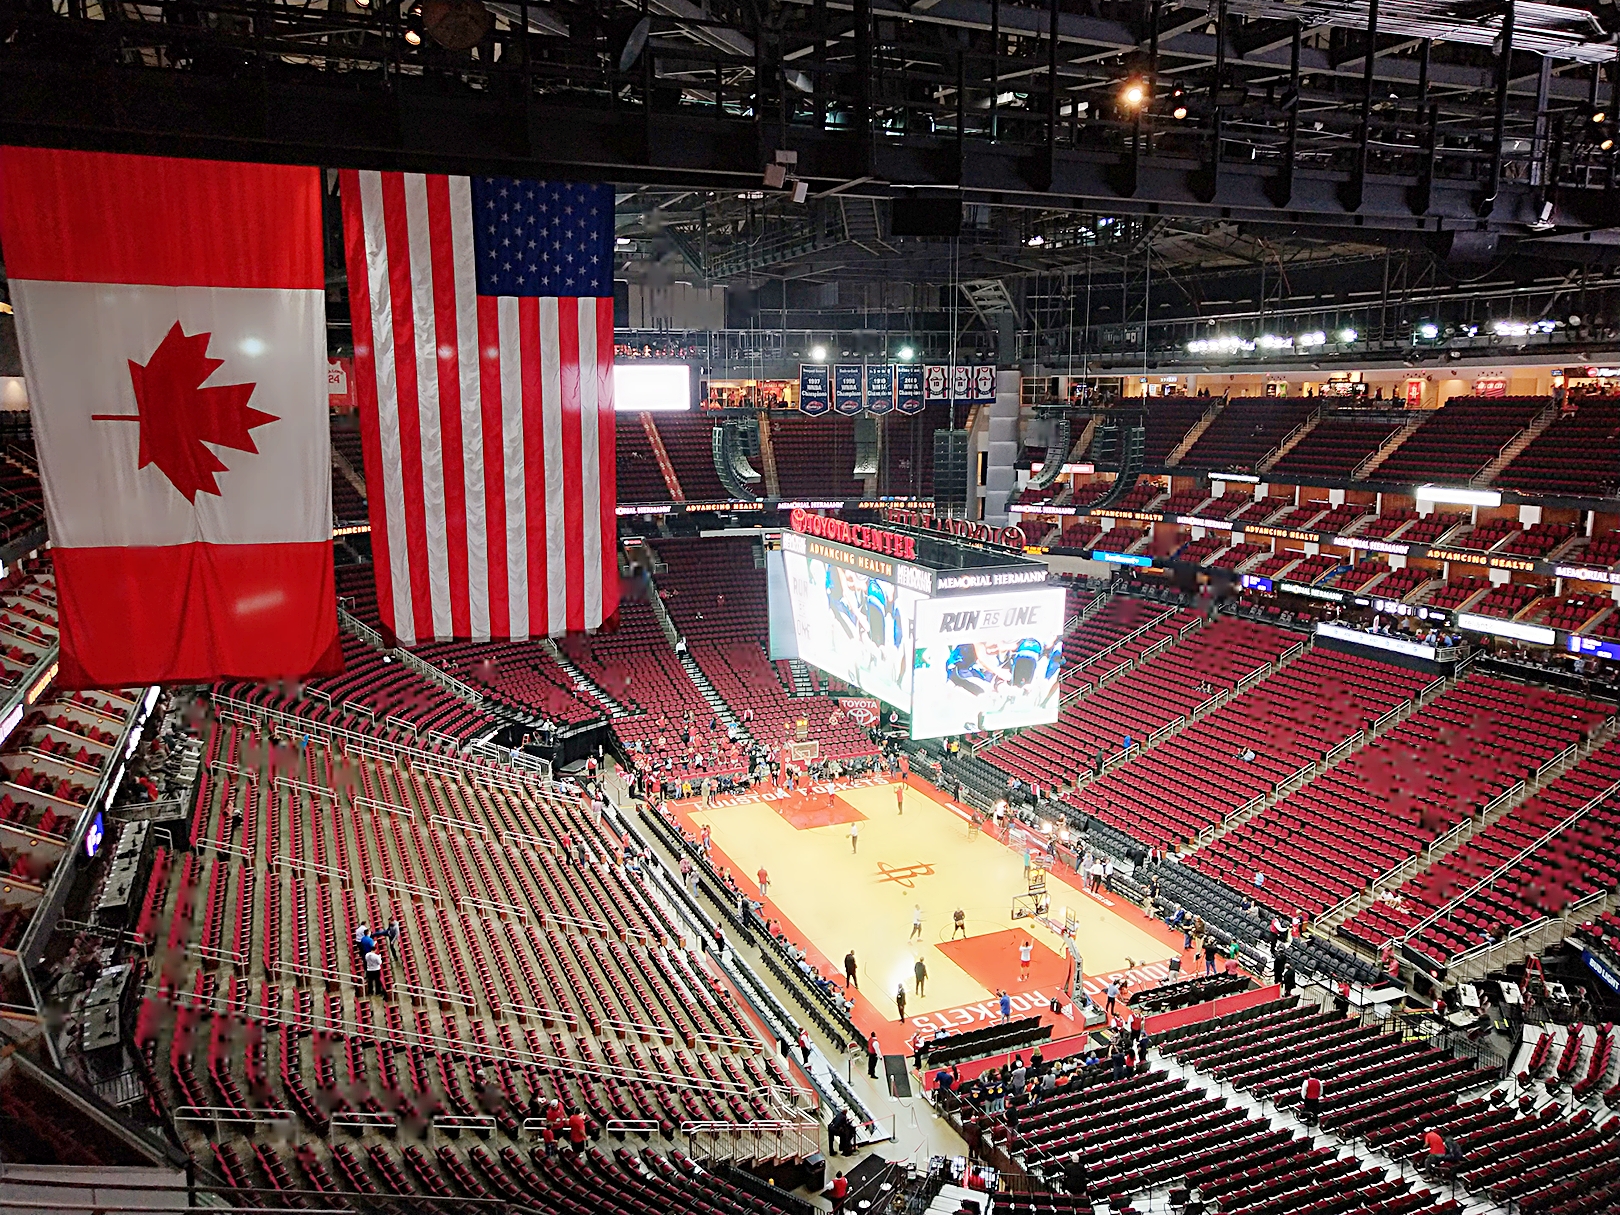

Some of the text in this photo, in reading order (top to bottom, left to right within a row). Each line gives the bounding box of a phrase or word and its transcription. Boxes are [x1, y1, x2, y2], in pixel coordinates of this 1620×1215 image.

[328, 375, 340, 383] 24
[685, 502, 763, 512] ADVANCING HEALTH
[1010, 504, 1043, 514] MEMORIAL
[1090, 509, 1164, 522] ADVANCING HEALTH
[806, 513, 918, 561] TOYOTA CENTER
[1244, 525, 1320, 542] ADVANCING HEALTH
[1333, 536, 1370, 549] MEMORIAL
[809, 542, 892, 576] ADVANCING HEALTH
[1426, 549, 1535, 572] ADVANCING HEALTH
[897, 564, 932, 580] MEMORIAL
[938, 570, 1048, 589] MEMORIAL HERMANN
[1555, 566, 1609, 582] MEMORIAL
[1280, 583, 1311, 596] MEMORIAL
[939, 610, 981, 633] RUN
[1003, 606, 1041, 627] ONE
[842, 700, 877, 709] TOYOTA
[1589, 957, 1620, 990] BUD LIGHT
